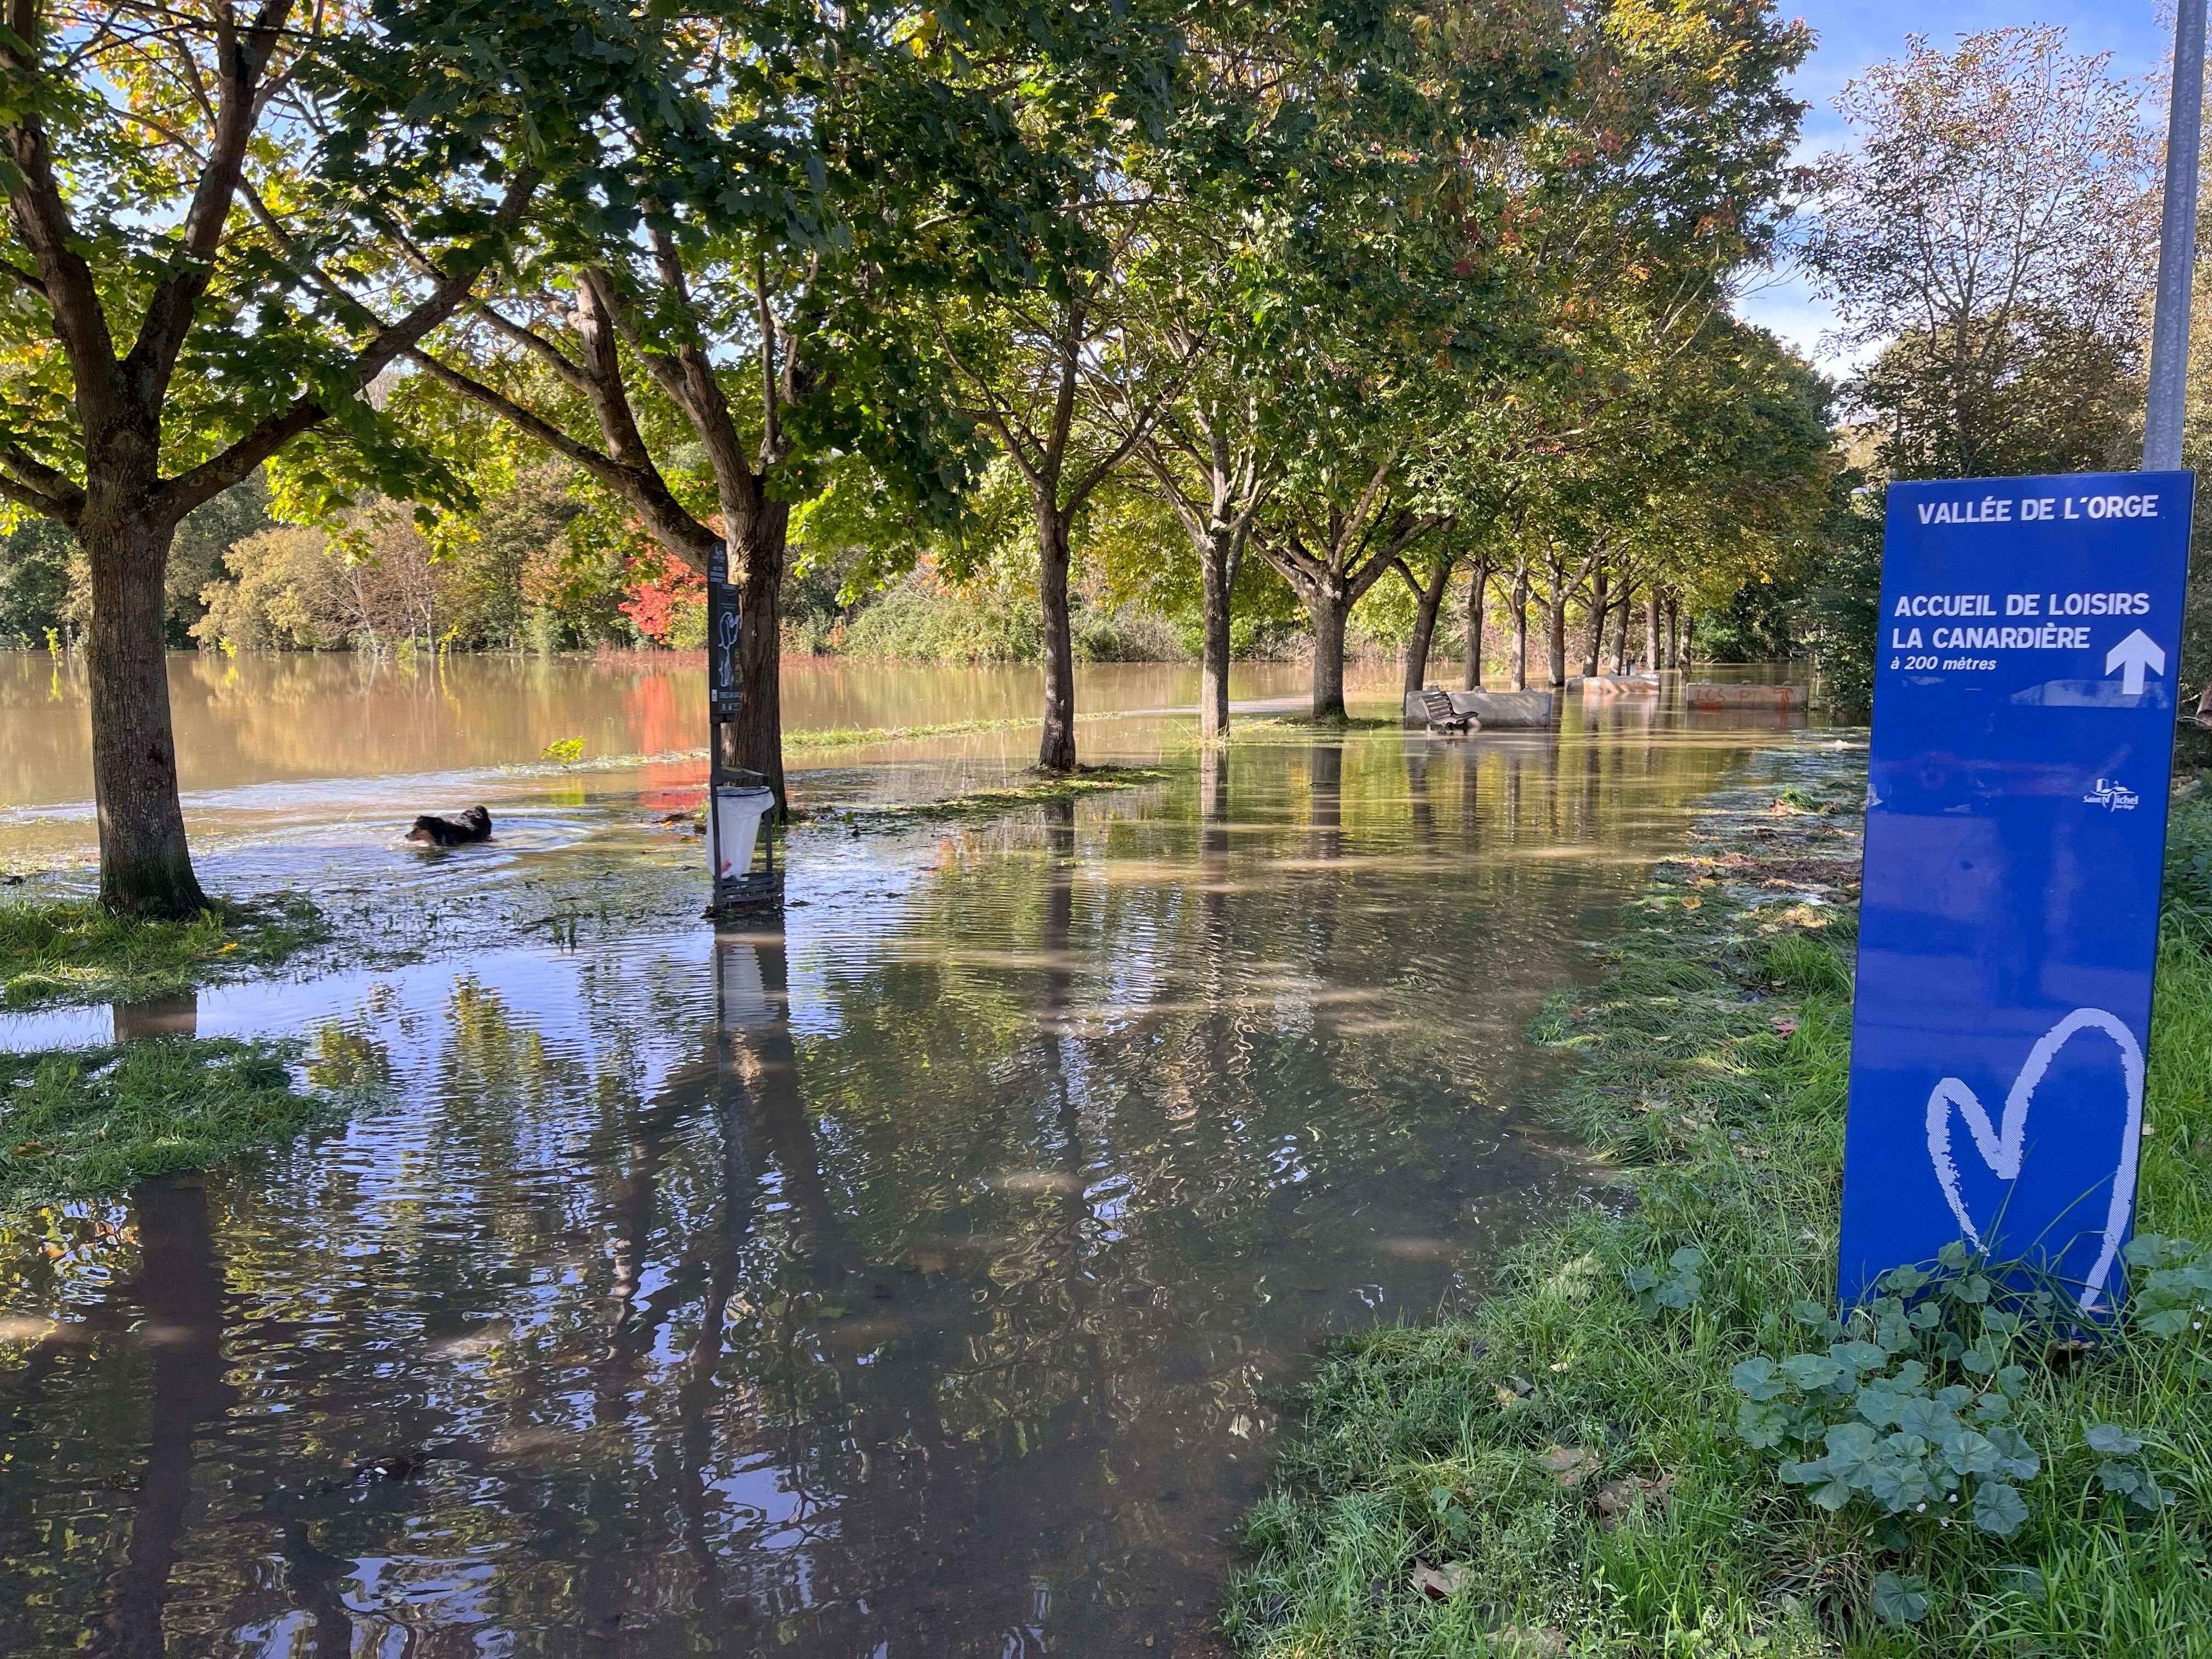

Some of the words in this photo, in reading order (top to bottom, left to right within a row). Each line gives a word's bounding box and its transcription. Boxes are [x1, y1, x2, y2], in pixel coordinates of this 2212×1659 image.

[1918, 496, 2012, 524] VALLÉE
[2021, 498, 2055, 521] DE
[2064, 495, 2159, 519] L'ORGE
[1894, 595, 1997, 617] ACCUEIL
[2006, 594, 2040, 616] DE
[2049, 592, 2149, 615] LOISIRS
[1892, 628, 1923, 648] LA
[1933, 623, 2090, 648] CANARDIÈRE
[1891, 656, 1900, 669] à
[1904, 656, 1938, 670] 200
[1943, 657, 1997, 670] mètres
